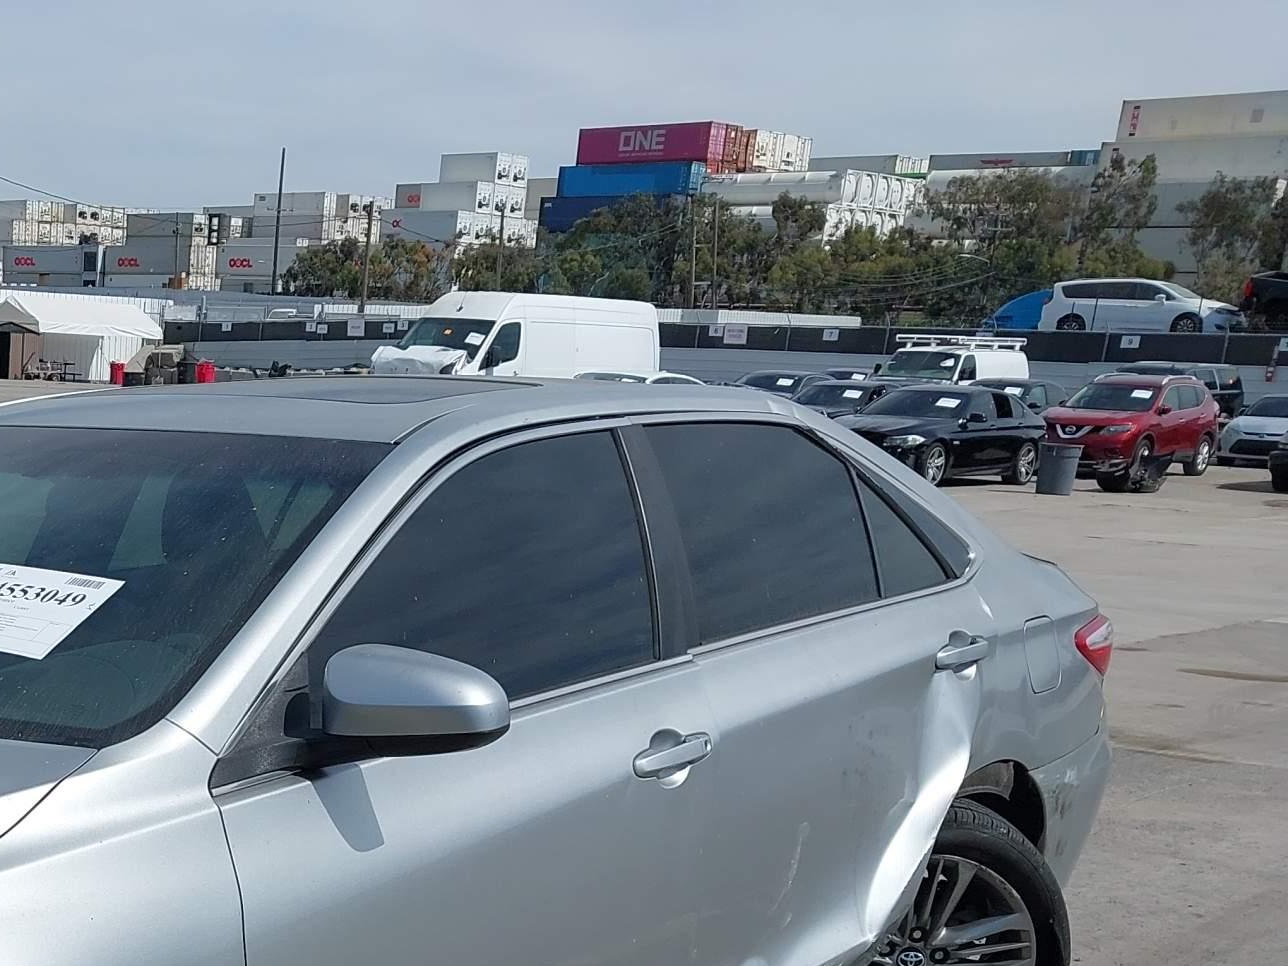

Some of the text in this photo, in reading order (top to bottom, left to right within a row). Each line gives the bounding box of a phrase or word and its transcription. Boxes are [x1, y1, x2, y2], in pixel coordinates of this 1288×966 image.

[618, 130, 666, 151] ONE
[14, 257, 35, 266] OOCL
[117, 257, 139, 267] OOCL
[228, 257, 253, 268] OOCL
